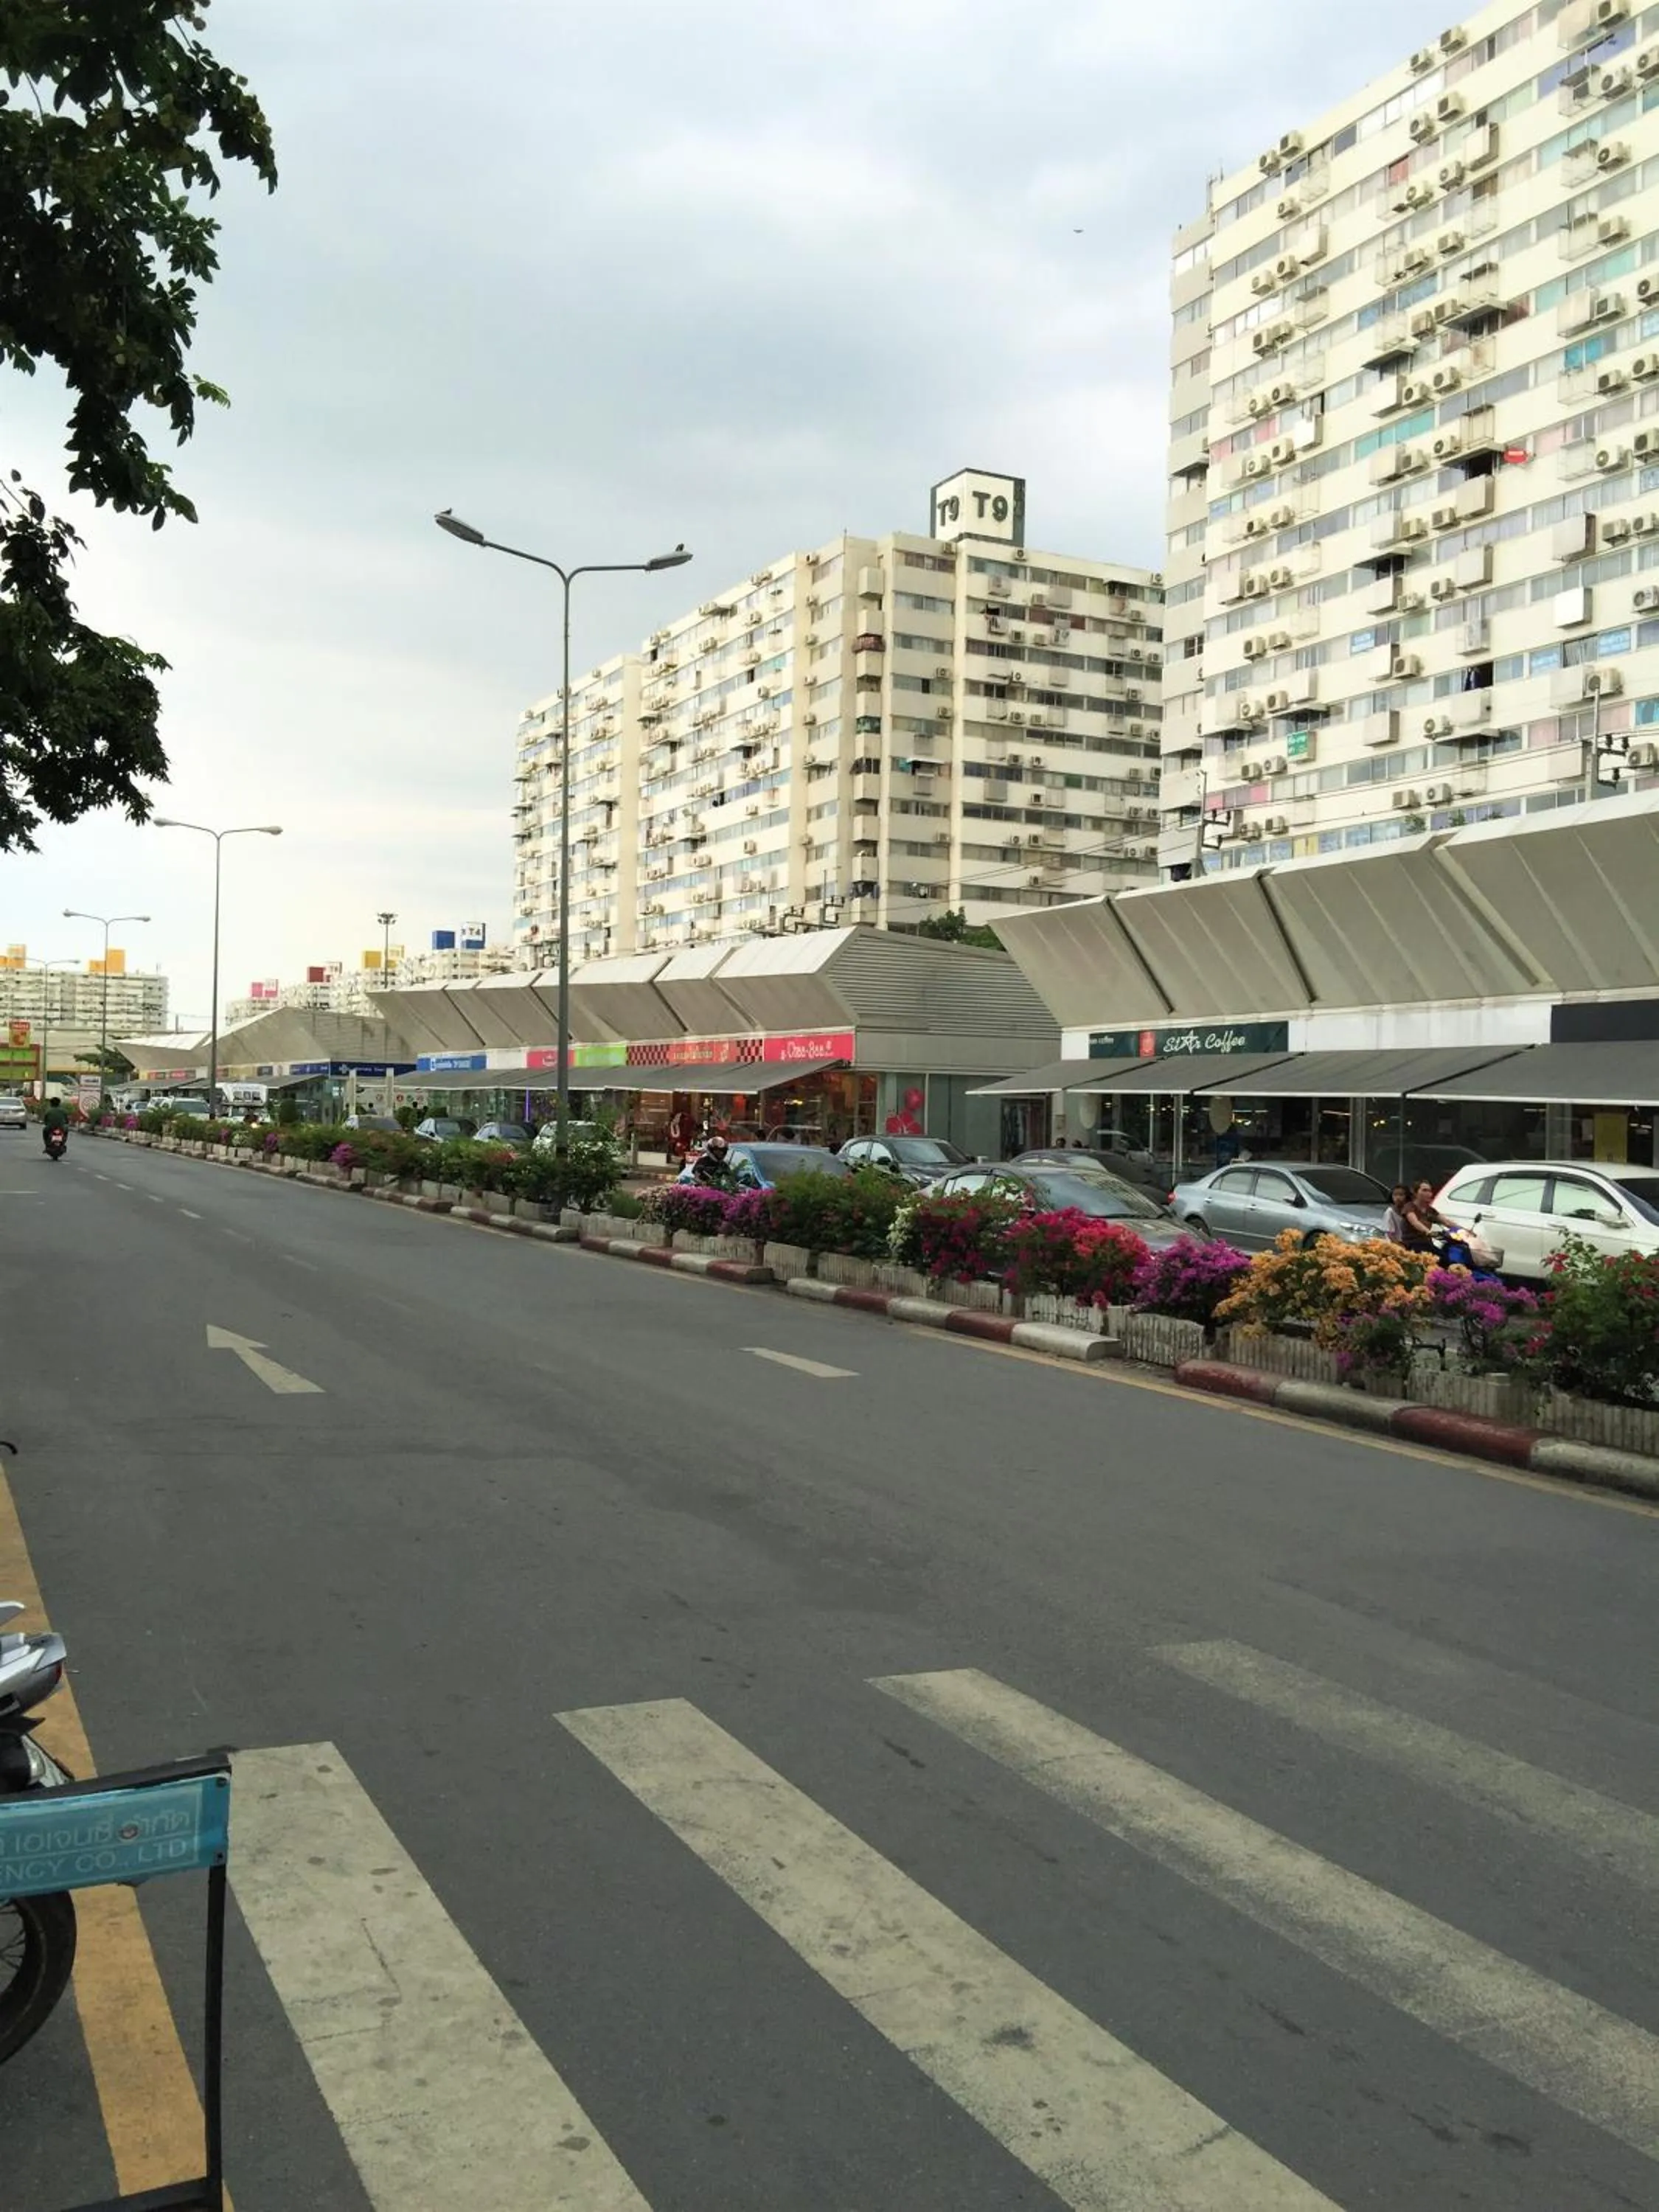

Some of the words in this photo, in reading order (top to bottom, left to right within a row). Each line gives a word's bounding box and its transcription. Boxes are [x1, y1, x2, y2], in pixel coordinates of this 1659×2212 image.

[937, 495, 959, 526] T9
[972, 490, 1008, 522] T9
[1204, 1029, 1246, 1053] Coffee
[0, 1857, 67, 1885] NCY
